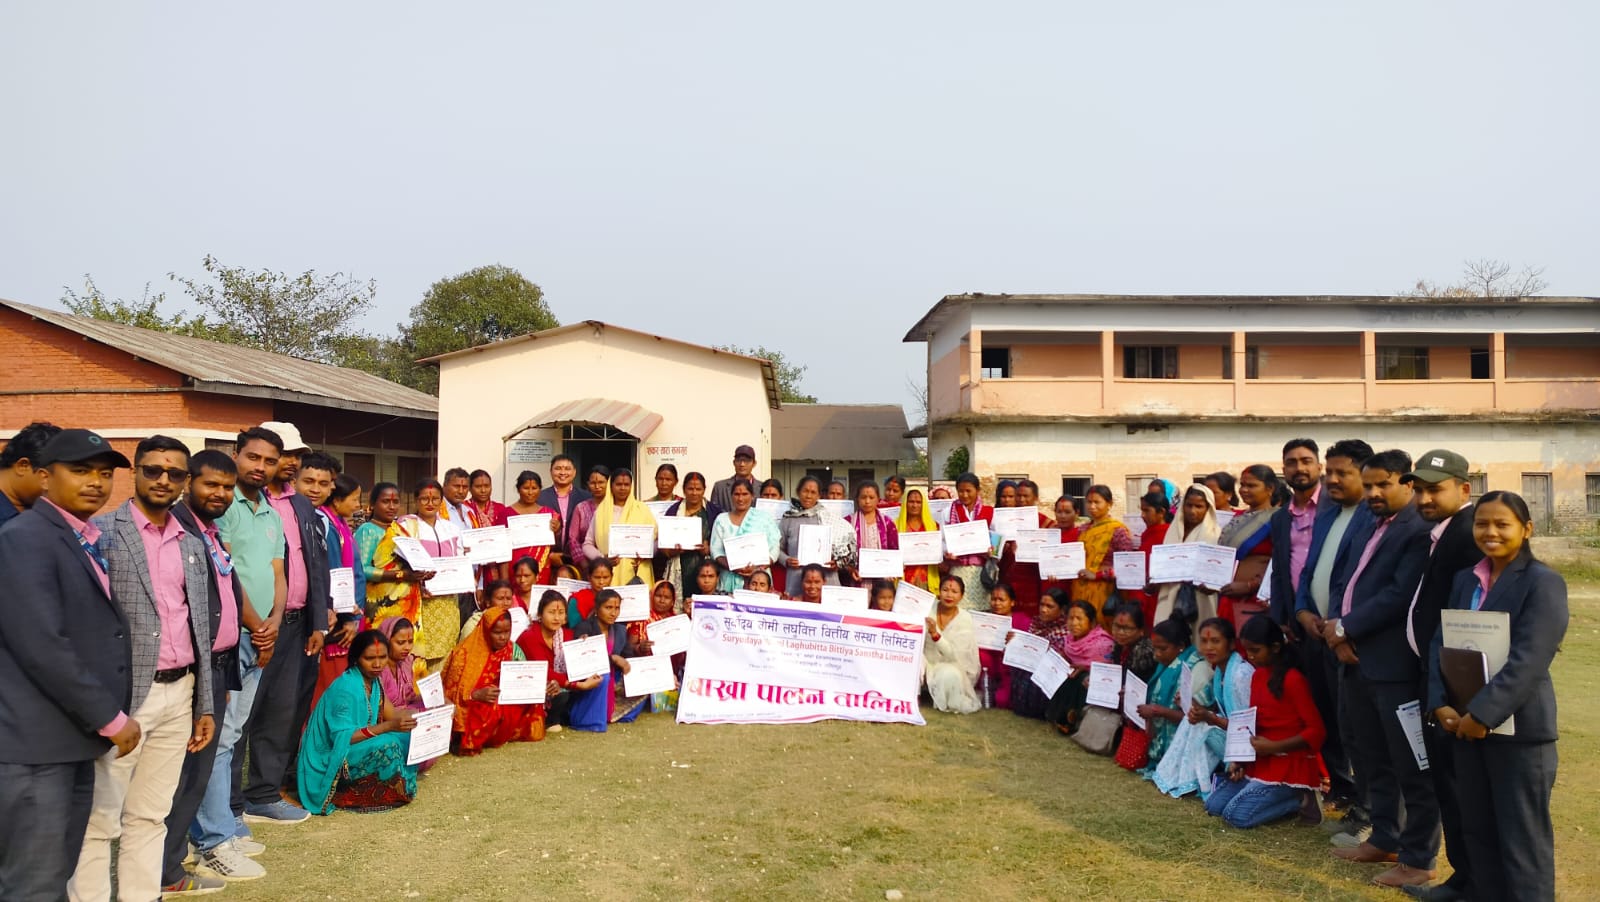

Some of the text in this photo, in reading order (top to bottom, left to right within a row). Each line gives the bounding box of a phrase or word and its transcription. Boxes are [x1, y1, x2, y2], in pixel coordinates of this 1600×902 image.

[786, 640, 828, 653] Laghubitta
[829, 645, 854, 657] Bittiya
[885, 653, 914, 664] Limited
[756, 683, 825, 705] पालन
[833, 689, 913, 716] तालिम
